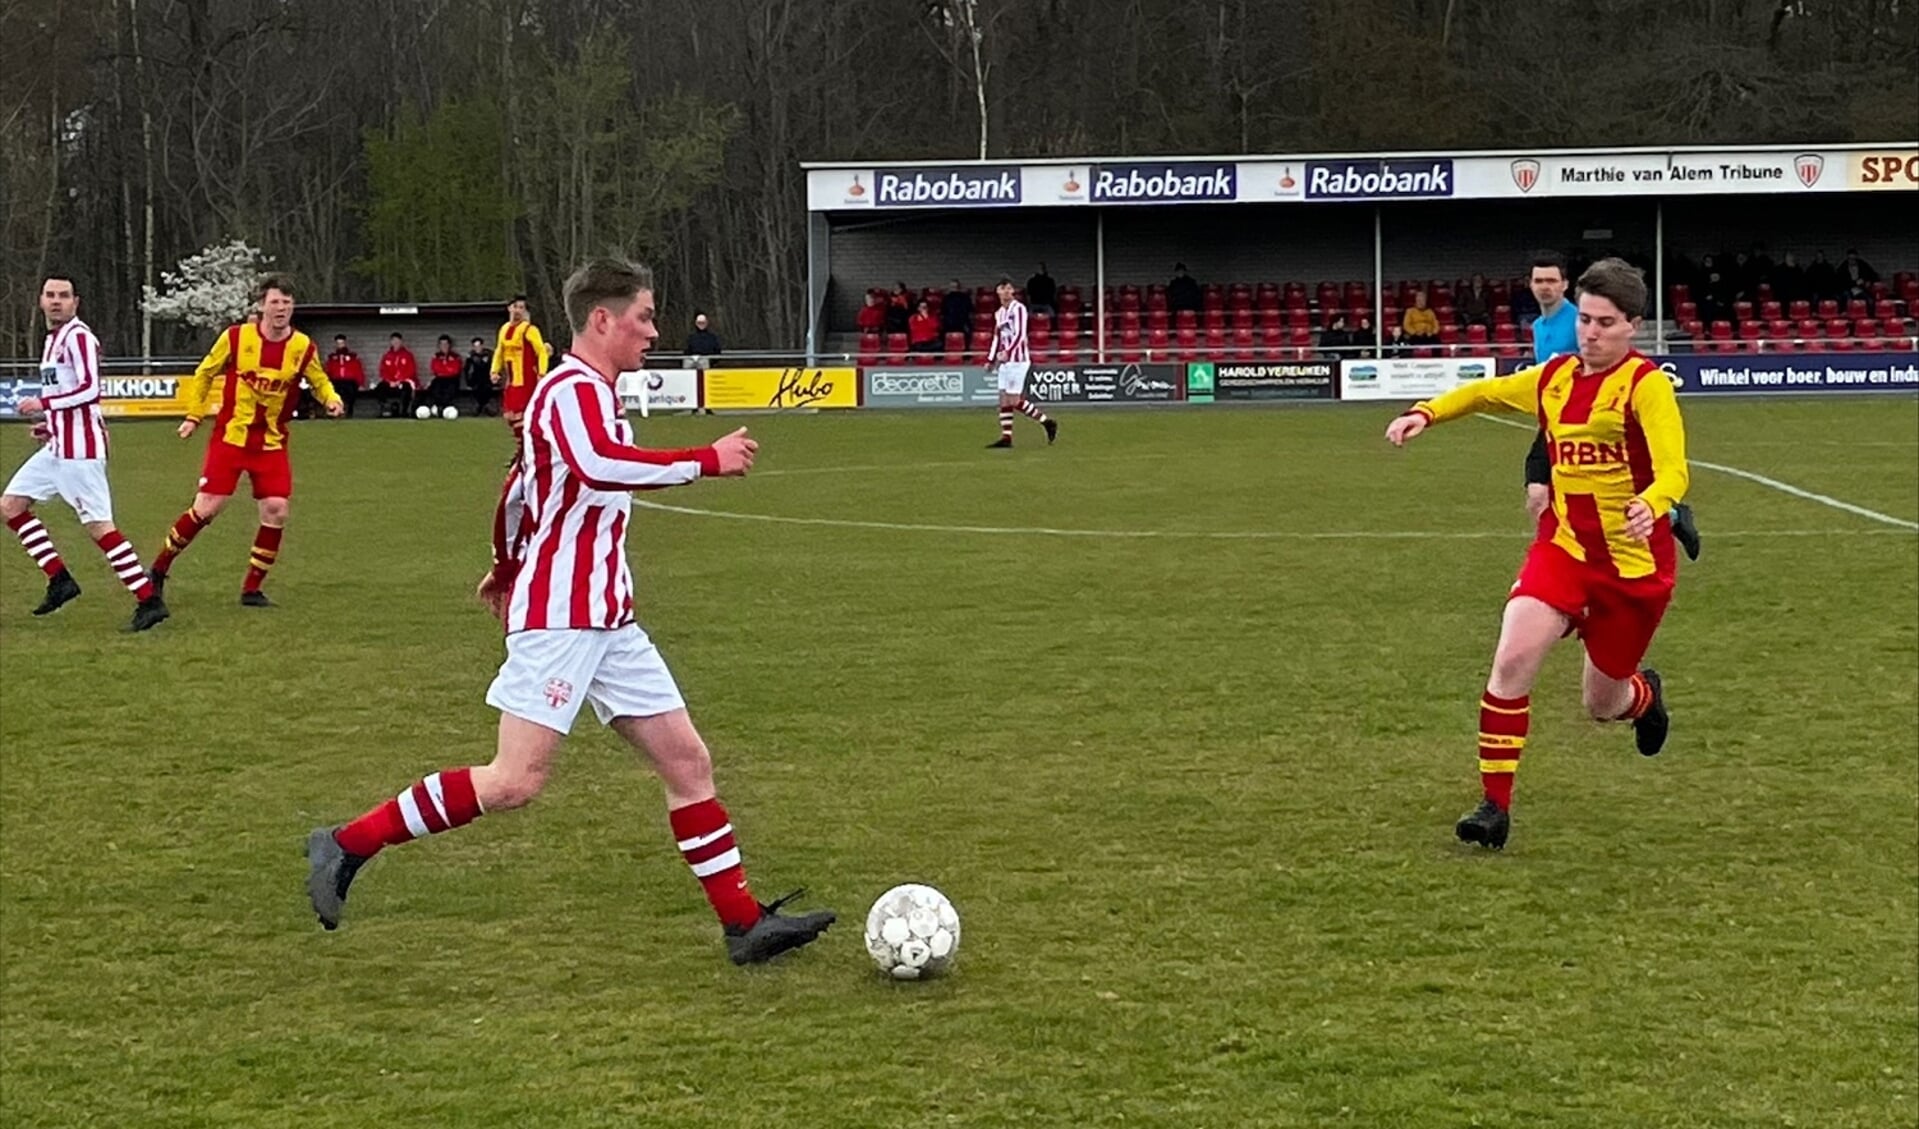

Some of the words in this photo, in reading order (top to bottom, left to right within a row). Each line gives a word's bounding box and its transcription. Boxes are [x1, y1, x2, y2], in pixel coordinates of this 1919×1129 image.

[1310, 165, 1448, 194] Rabobank
[1561, 166, 1625, 182] Marthie
[1632, 169, 1663, 181] van
[1670, 165, 1713, 181] Alem
[1719, 163, 1783, 180] Tribune
[880, 173, 1016, 202] Rabobank
[1094, 170, 1231, 198] Rabobank
[1033, 371, 1076, 383] VOOR
[1218, 367, 1266, 378] HAROLD
[1699, 368, 1749, 386] Winkel
[1751, 371, 1784, 385] voor
[1826, 366, 1867, 384] bouw
[1869, 370, 1888, 383] en
[768, 367, 834, 407] Hubo
[1029, 383, 1081, 400] KAMER
